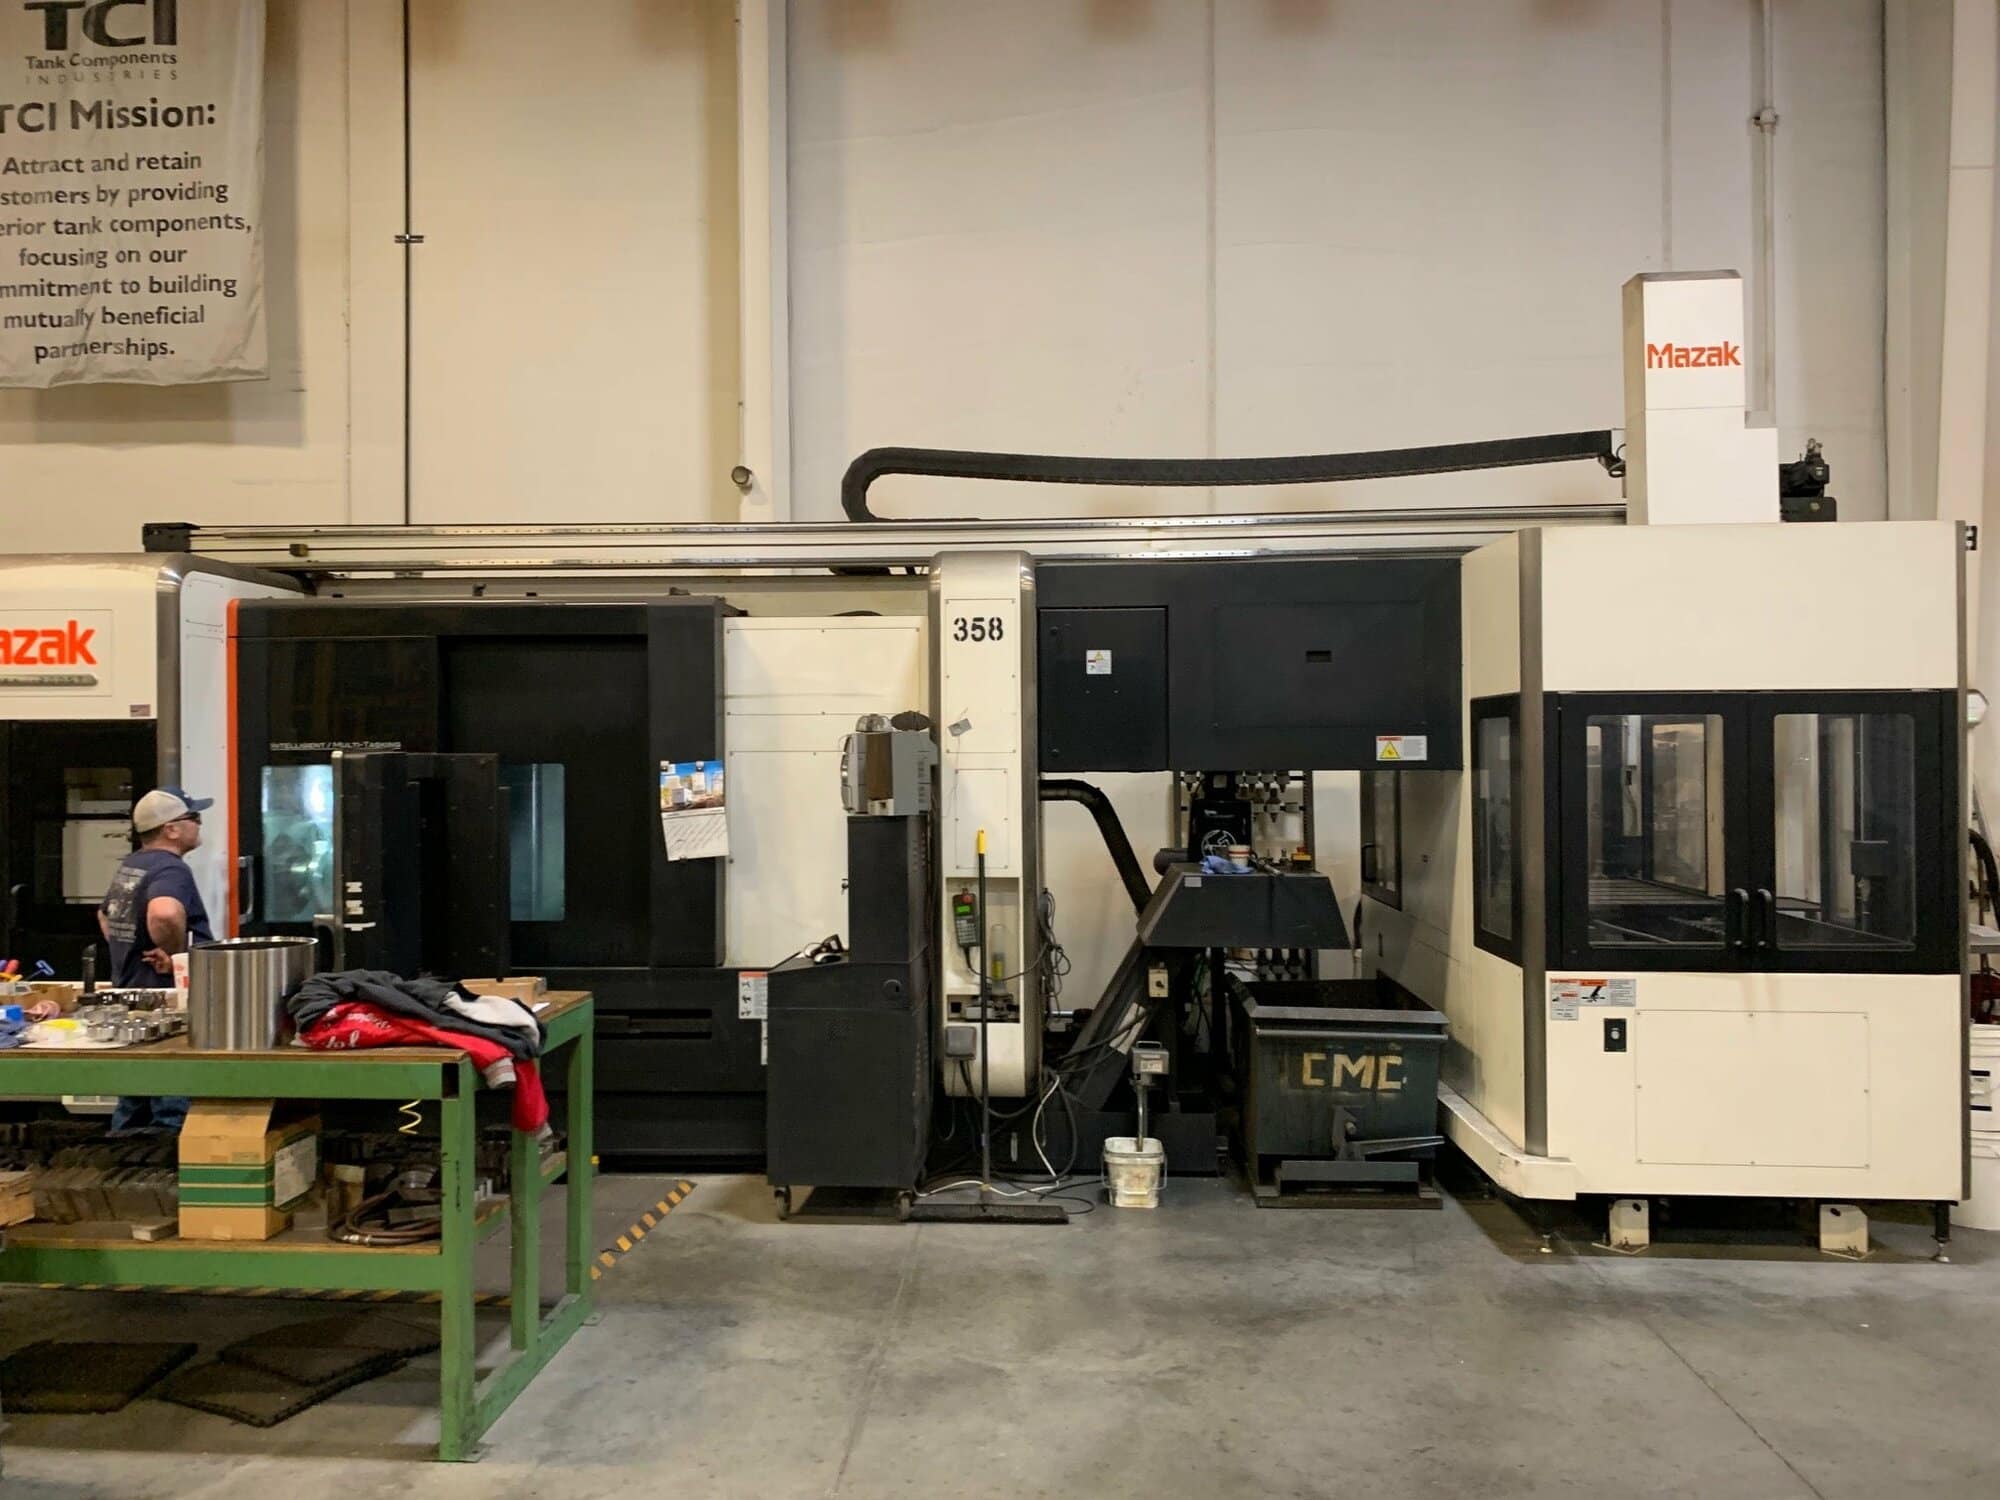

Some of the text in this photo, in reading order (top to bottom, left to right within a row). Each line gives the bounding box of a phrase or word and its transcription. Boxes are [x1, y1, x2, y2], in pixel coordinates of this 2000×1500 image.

[24, 0, 177, 50] TCI
[25, 53, 177, 69] Tank Components
[25, 70, 178, 85] INDUSTRIES
[71, 98, 215, 130] Mission:
[2, 151, 202, 175] Attract and retain
[96, 184, 120, 207] by
[128, 181, 228, 207] providing
[54, 216, 102, 235] tank
[110, 213, 252, 237] components,
[19, 248, 187, 268] focusing on our
[121, 279, 140, 294] to
[149, 274, 237, 297] building
[4, 305, 205, 331] mutually beneficial
[34, 338, 175, 363] partnerships.
[1647, 341, 1741, 368] Mazak
[953, 617, 1003, 642] 358
[1302, 1052, 1403, 1090] CMC
